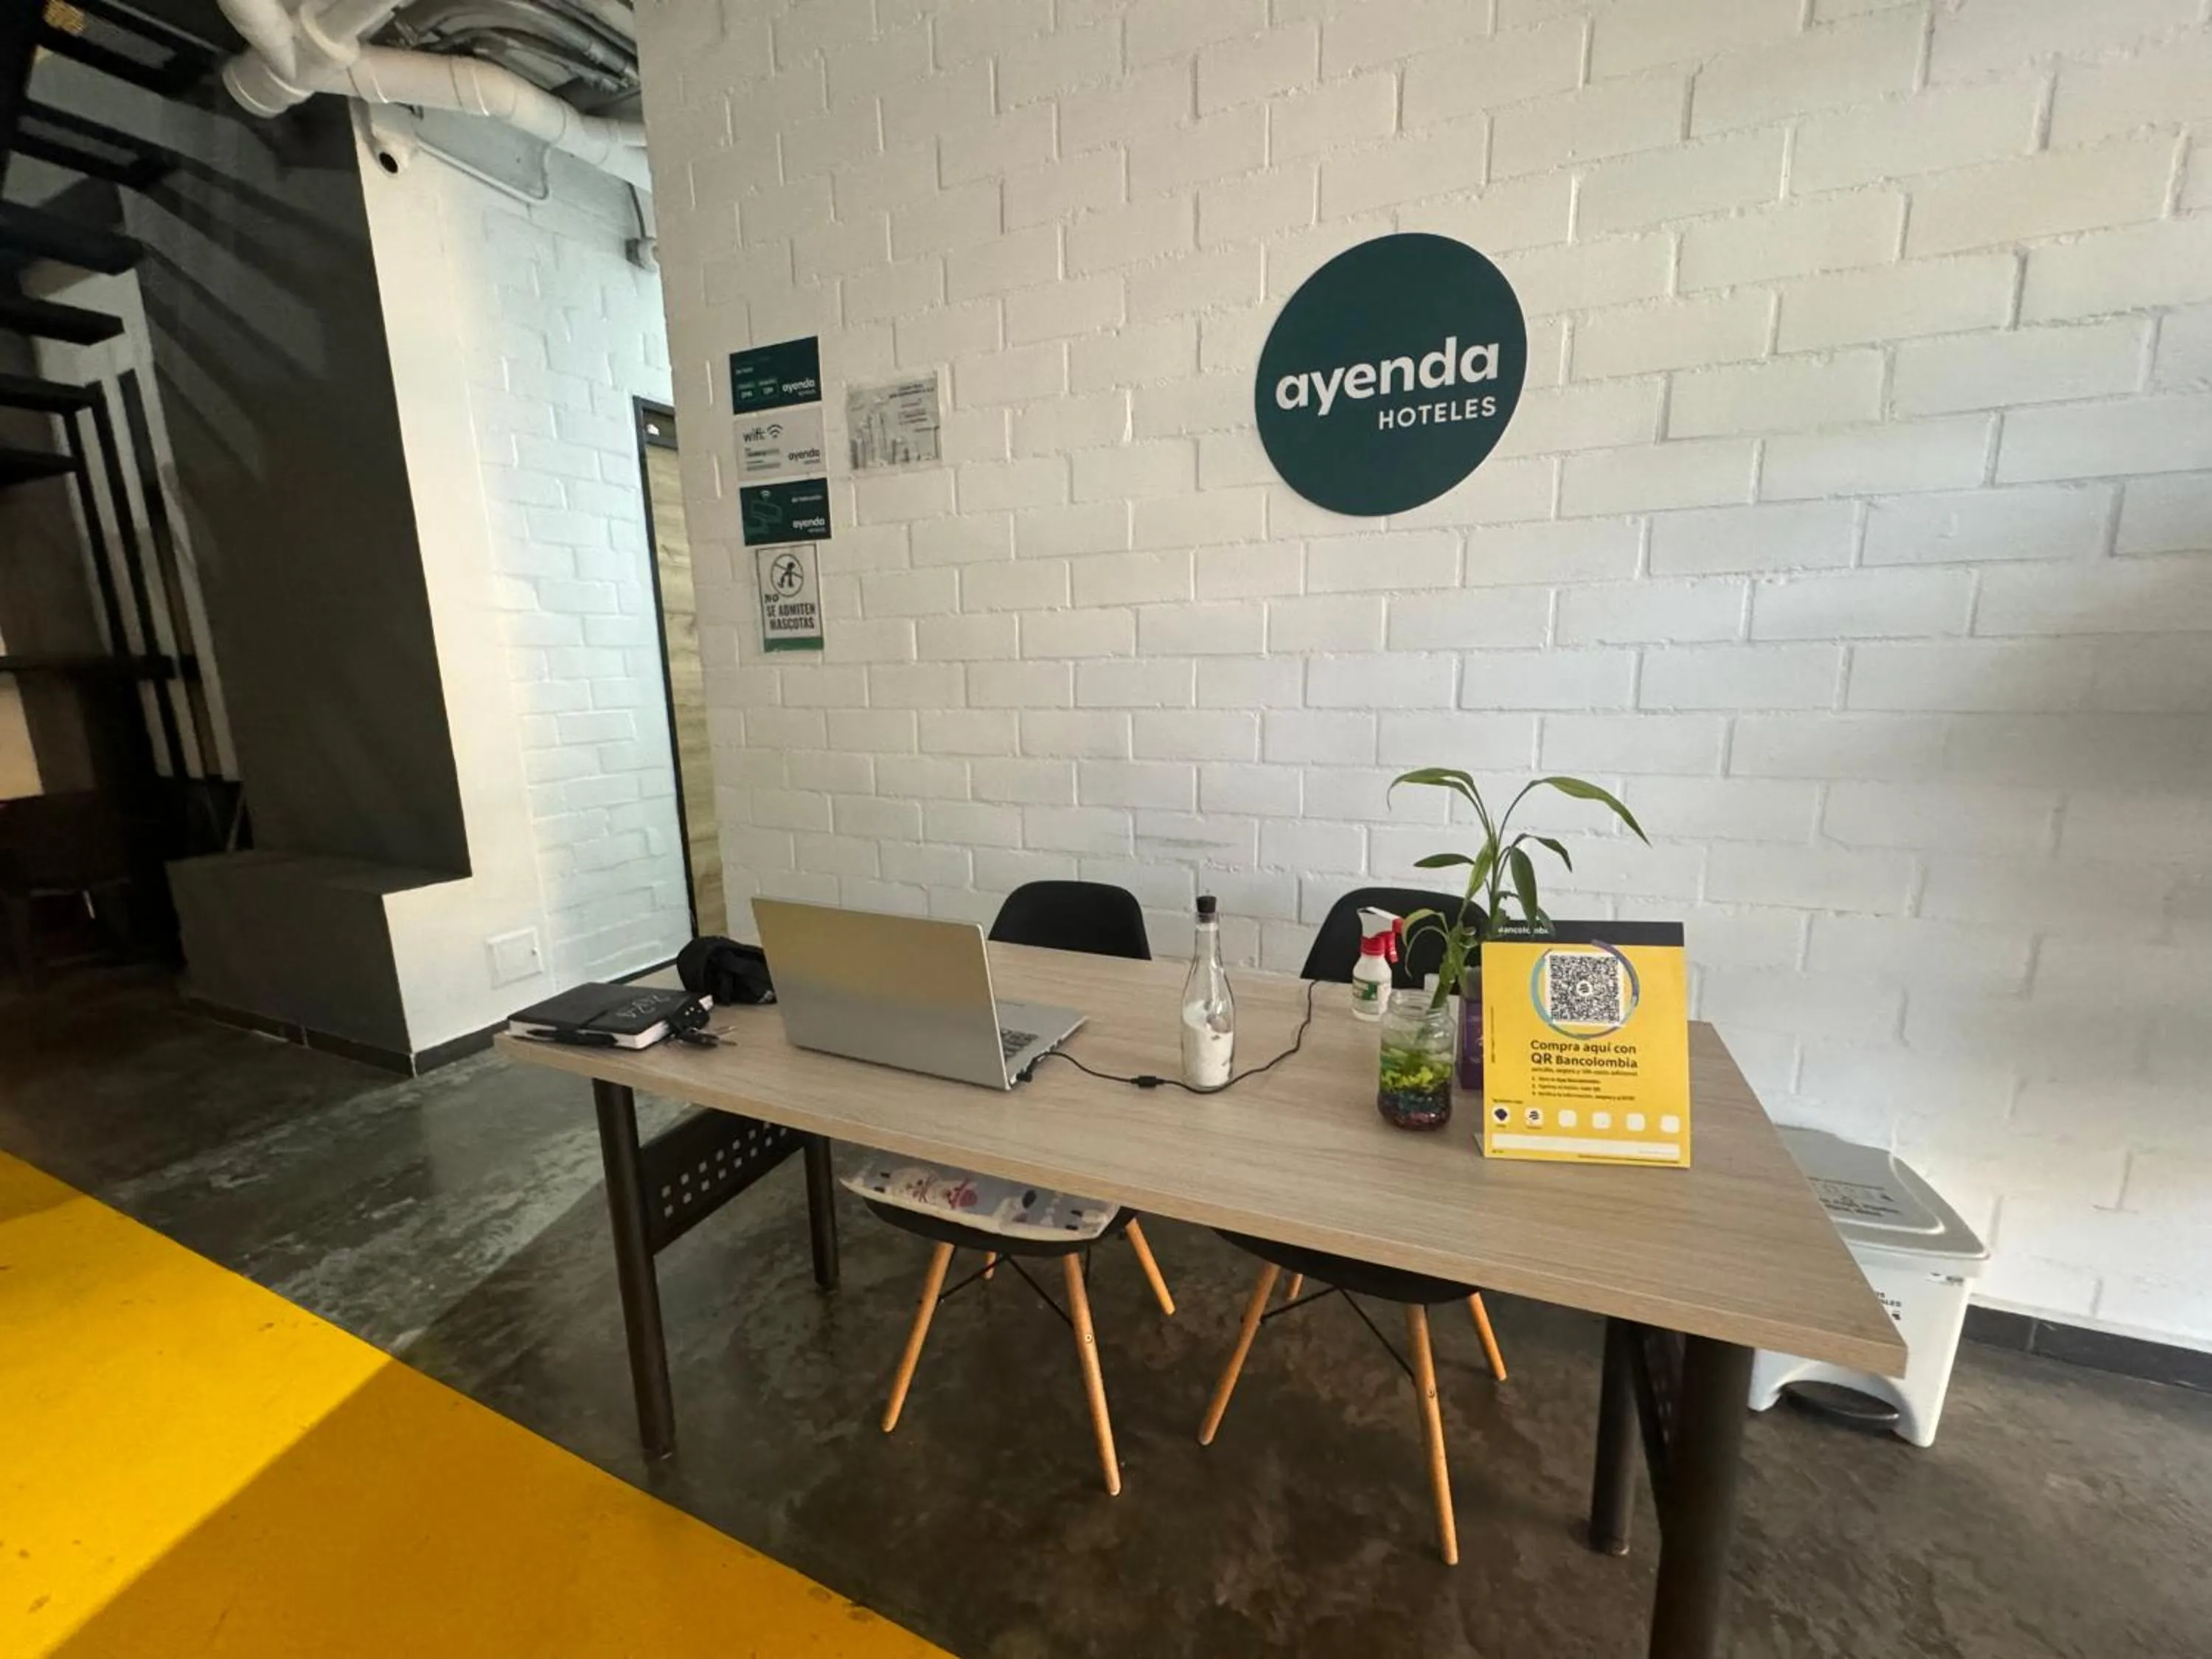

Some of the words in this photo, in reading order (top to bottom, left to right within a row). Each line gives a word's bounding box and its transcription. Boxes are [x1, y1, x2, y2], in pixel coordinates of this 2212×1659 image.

[1276, 335, 1500, 417] ayenda
[1379, 396, 1497, 430] HOTELES
[765, 593, 779, 603] NO
[767, 605, 776, 617] SE
[779, 602, 815, 616] ADMITEN
[770, 616, 815, 630] MASCOTAS
[1530, 1040, 1580, 1053] Compra
[1613, 1045, 1637, 1054] con
[1531, 1052, 1552, 1065] QR
[1555, 1055, 1638, 1068] Bancolombia
